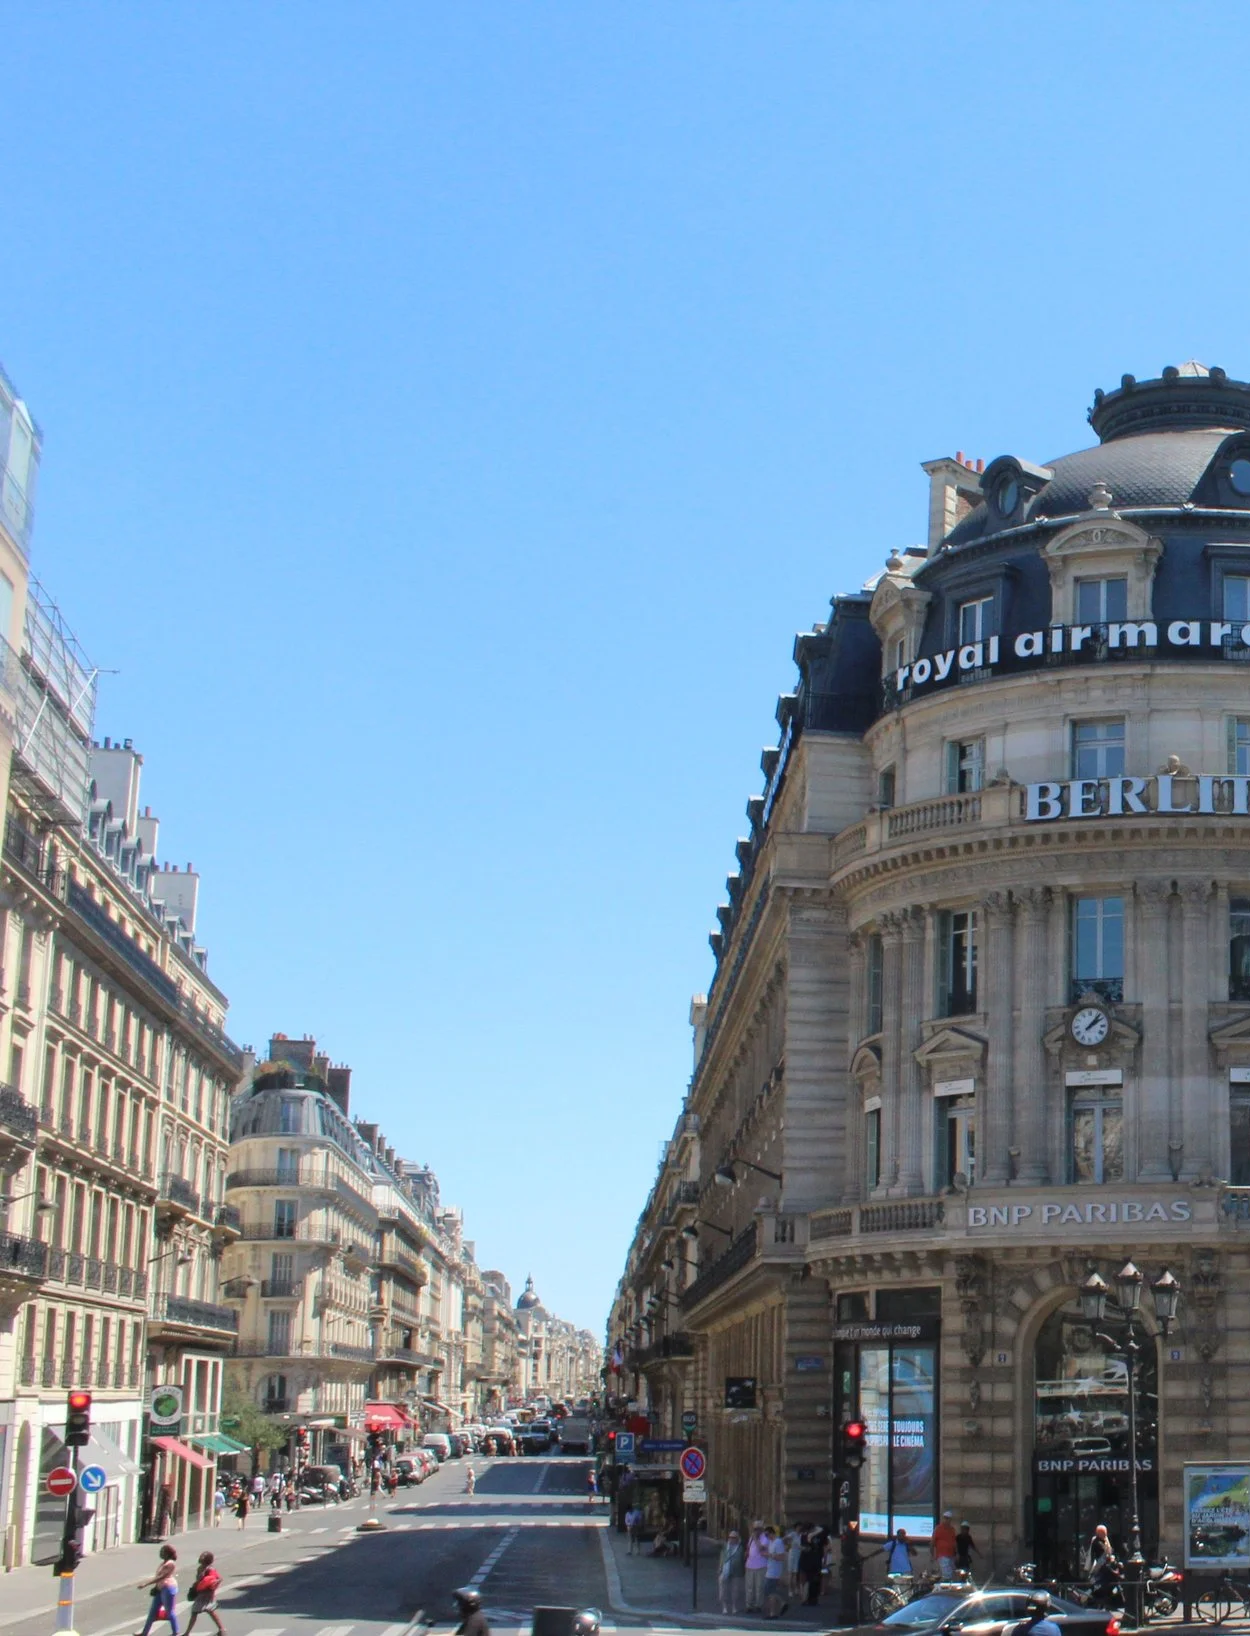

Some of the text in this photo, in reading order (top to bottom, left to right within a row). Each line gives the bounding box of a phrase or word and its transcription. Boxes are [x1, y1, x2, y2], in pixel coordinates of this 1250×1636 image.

[897, 635, 999, 692] royal
[1014, 623, 1092, 658] air
[968, 1200, 1191, 1227] BNP PARIBAS
[894, 1324, 921, 1338] change
[1038, 1459, 1153, 1472] BNP PARIBAS
